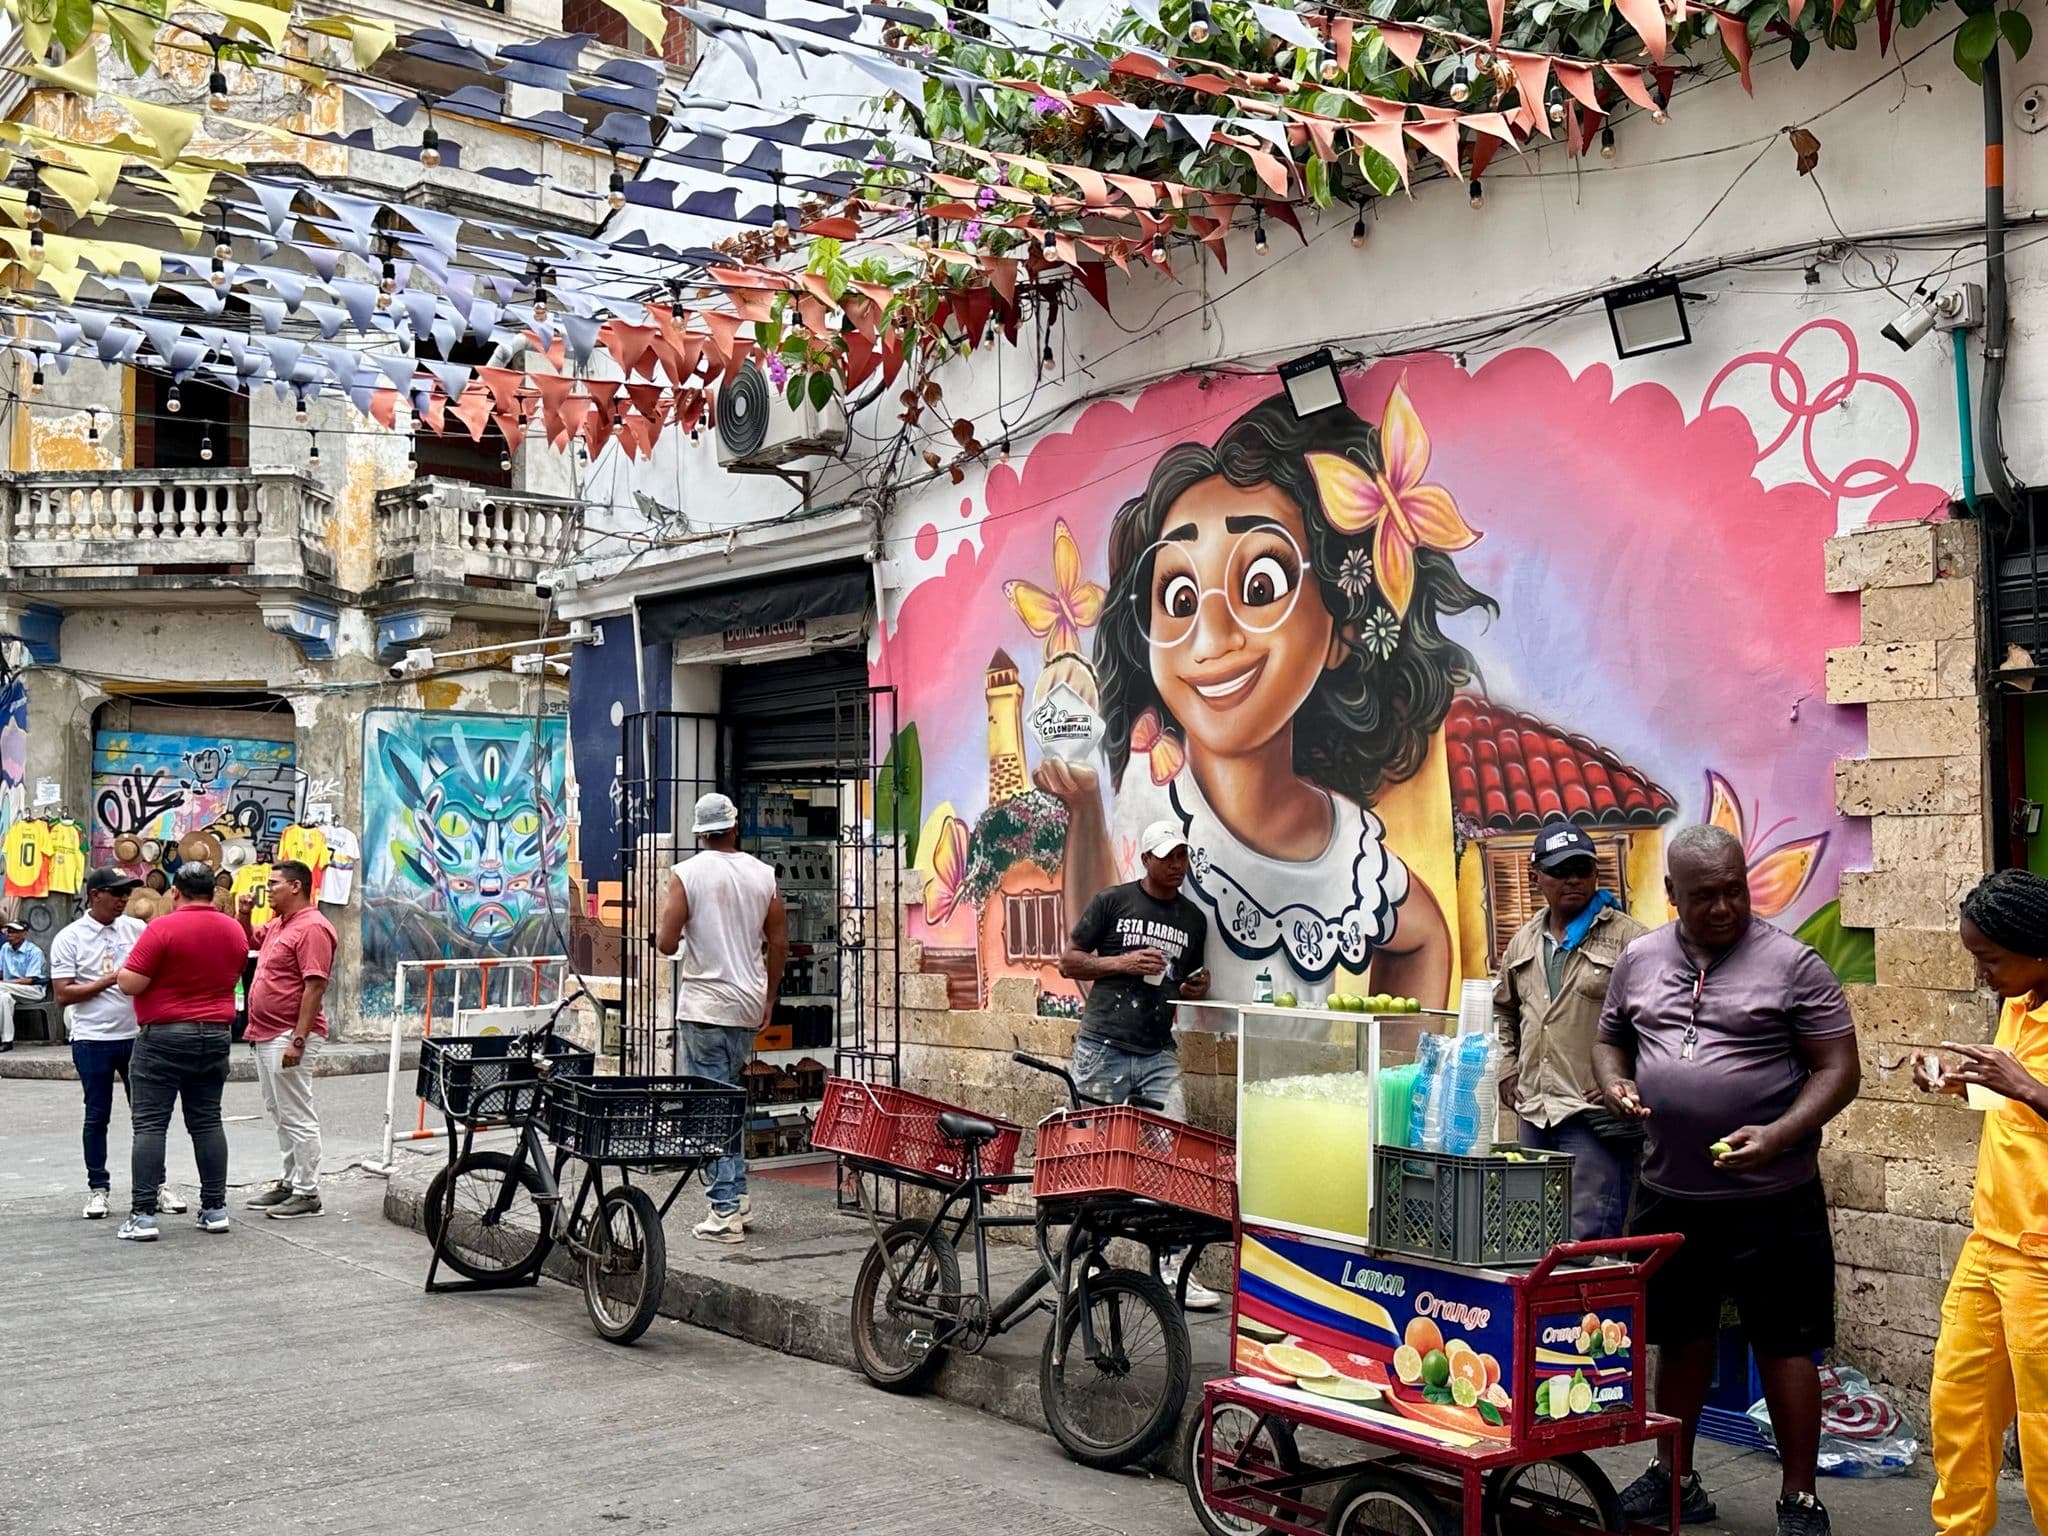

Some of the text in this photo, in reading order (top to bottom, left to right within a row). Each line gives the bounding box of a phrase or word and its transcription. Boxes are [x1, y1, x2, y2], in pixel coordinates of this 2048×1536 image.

[20, 842, 35, 867] 10
[1116, 918, 1189, 947] ESTA BARRIGA
[1341, 1260, 1406, 1297] Lemon
[1414, 1291, 1491, 1331] Orange
